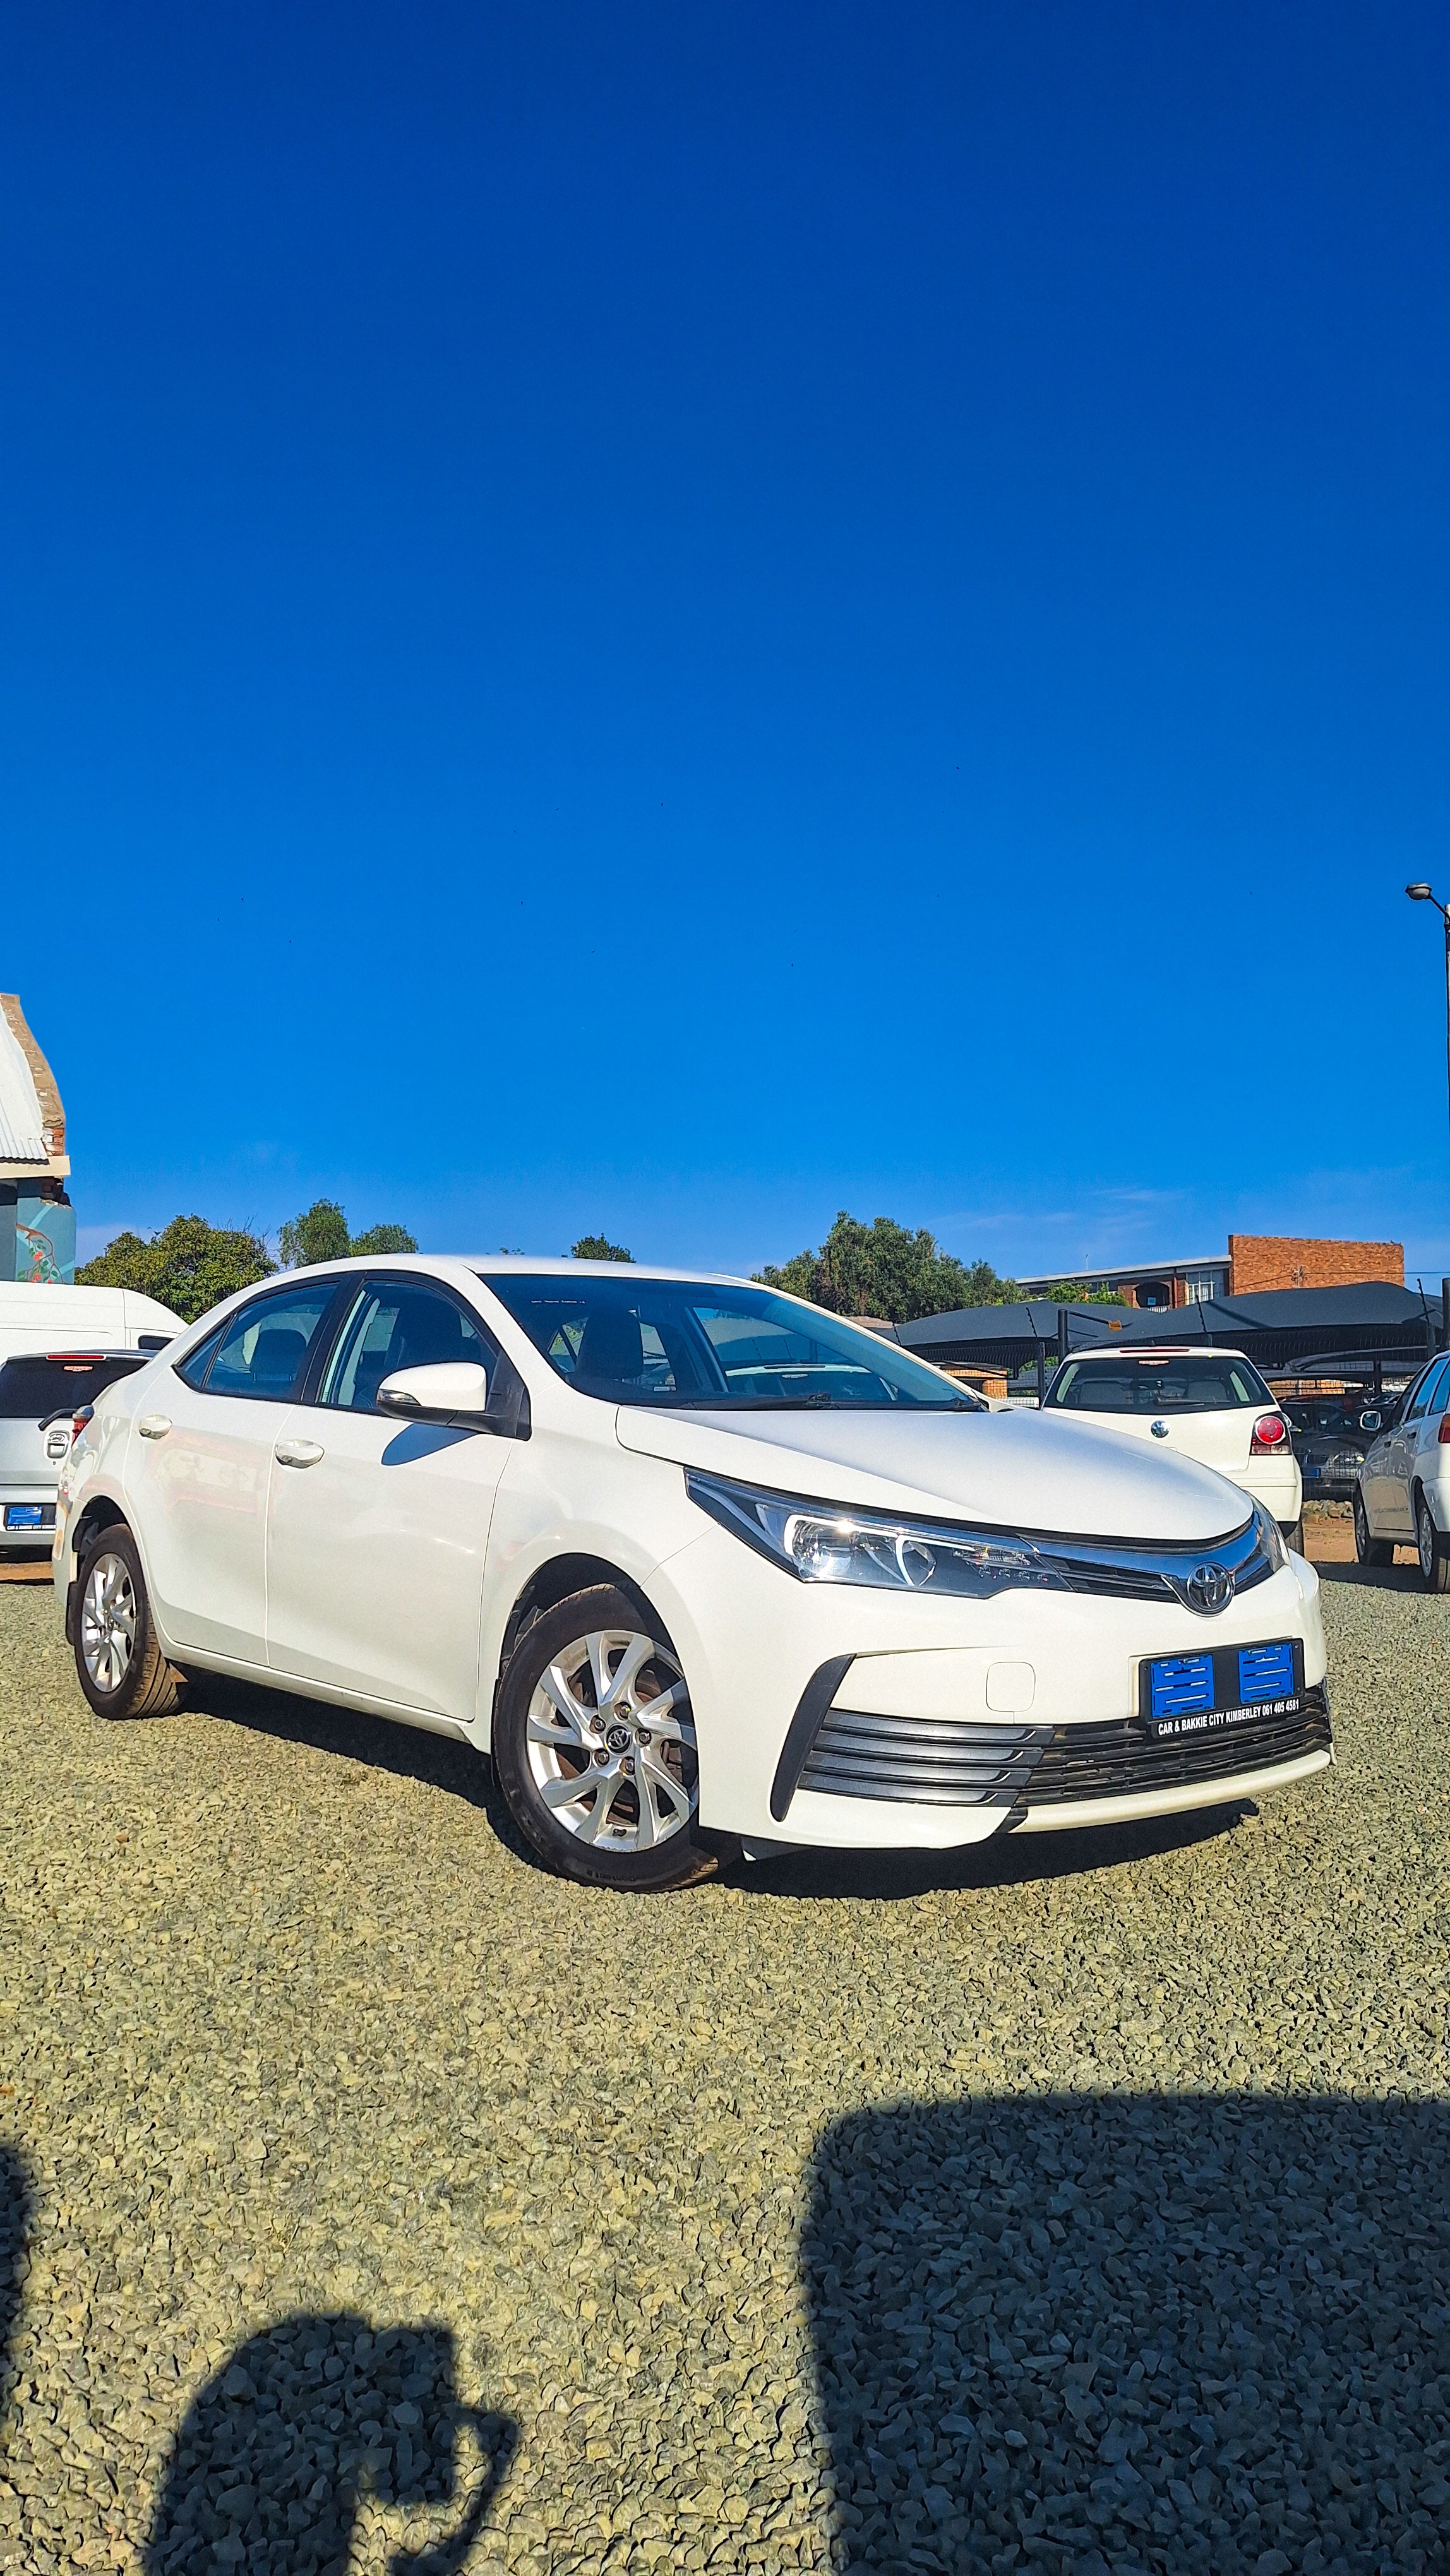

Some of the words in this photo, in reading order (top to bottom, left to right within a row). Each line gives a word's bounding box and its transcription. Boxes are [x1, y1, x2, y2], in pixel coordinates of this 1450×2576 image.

[1158, 1722, 1173, 1736] CAR
[1175, 1720, 1180, 1732] &
[1182, 1715, 1207, 1731] BAKKIE
[1209, 1712, 1225, 1726] CITY
[1226, 1705, 1261, 1723] KIMBERLEY
[1262, 1703, 1273, 1716] 061
[1274, 1701, 1285, 1714] 405
[1286, 1698, 1299, 1712] 4581
